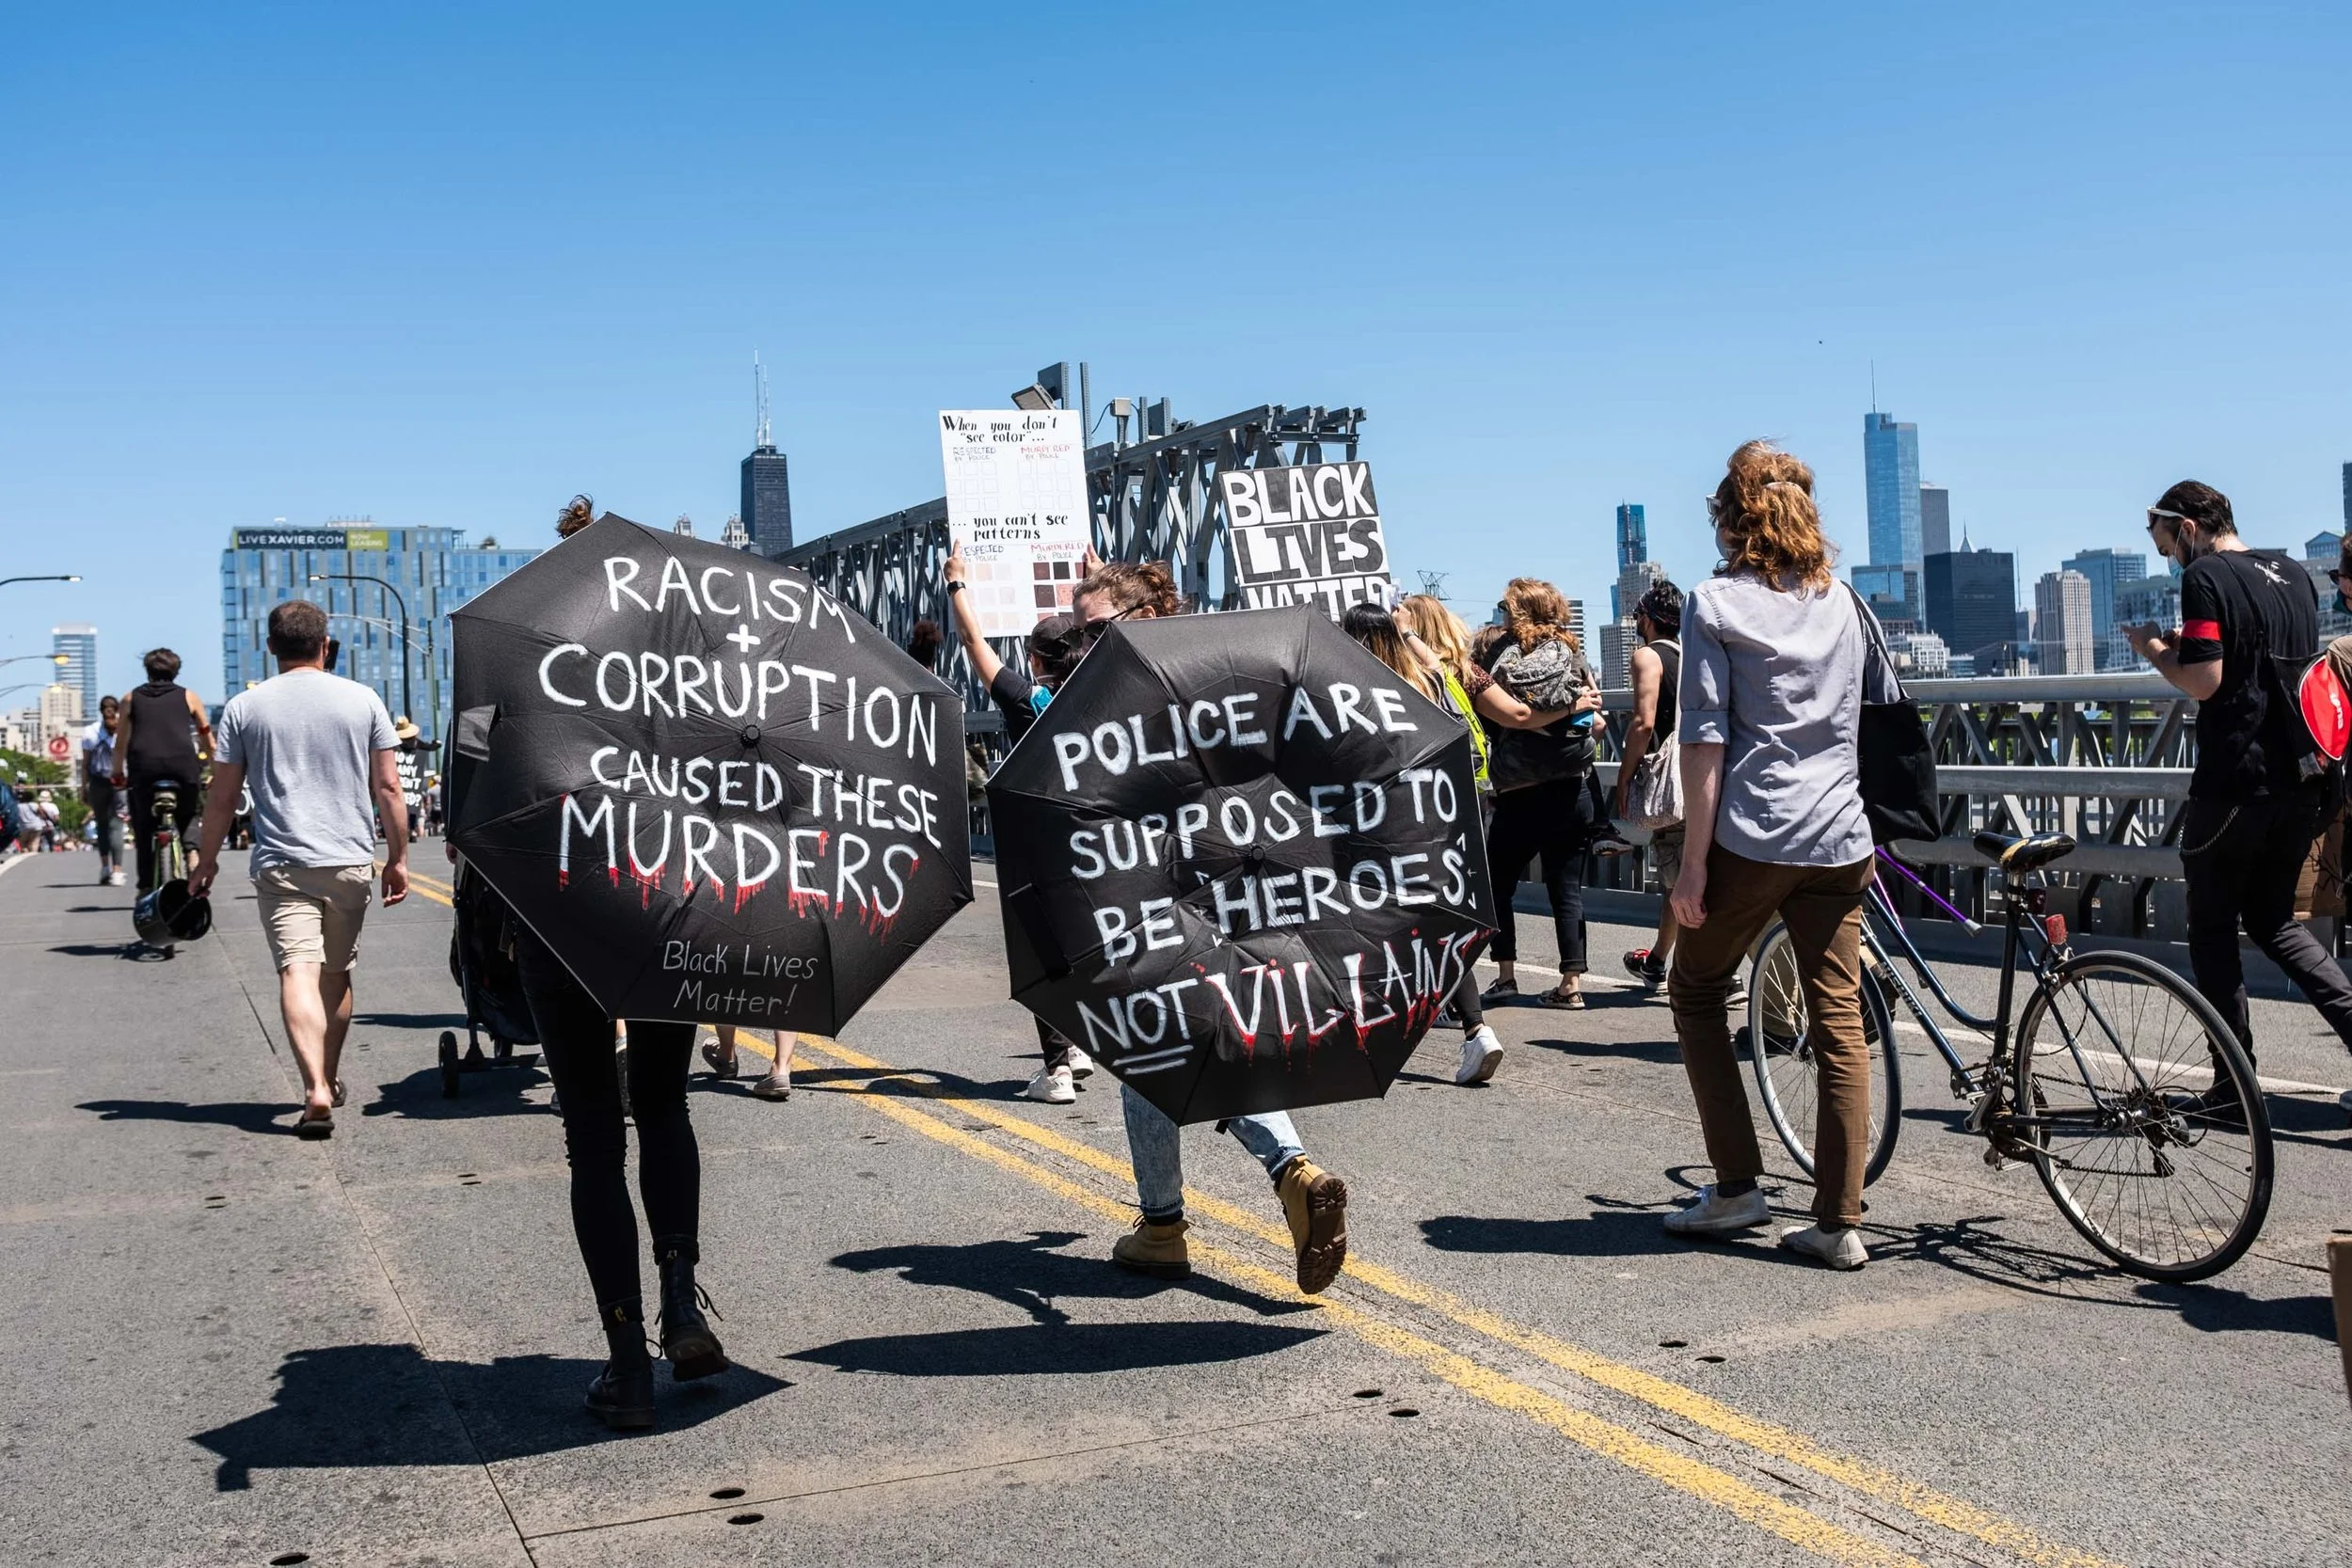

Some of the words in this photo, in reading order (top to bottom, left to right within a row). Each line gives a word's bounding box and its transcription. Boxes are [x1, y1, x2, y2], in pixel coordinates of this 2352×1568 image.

[943, 415, 977, 432] When
[991, 421, 1011, 434] you
[1022, 415, 1057, 430] don't
[974, 517, 997, 529] you
[1005, 513, 1037, 526] can't
[1046, 514, 1069, 526] see
[1222, 463, 1375, 527] BLACK
[974, 527, 1041, 542] patterns
[1234, 518, 1383, 583] LIVES
[603, 556, 856, 643] RACISM
[538, 643, 937, 767] CORRUPTION
[1052, 692, 1267, 792] POLICE
[1283, 682, 1419, 742] ARE
[395, 751, 416, 765] OW
[590, 747, 783, 812] CAUSED
[797, 762, 942, 849] THESE
[1070, 784, 1388, 880] SUPPOSED
[1399, 768, 1458, 825] TO
[559, 793, 920, 920] MURDERS
[1092, 896, 1184, 967] BE
[1211, 851, 1466, 934] HEROES
[663, 941, 727, 975] Black
[742, 943, 819, 980] Lives
[674, 978, 796, 1017] Matter!
[1075, 977, 1200, 1053] NOT
